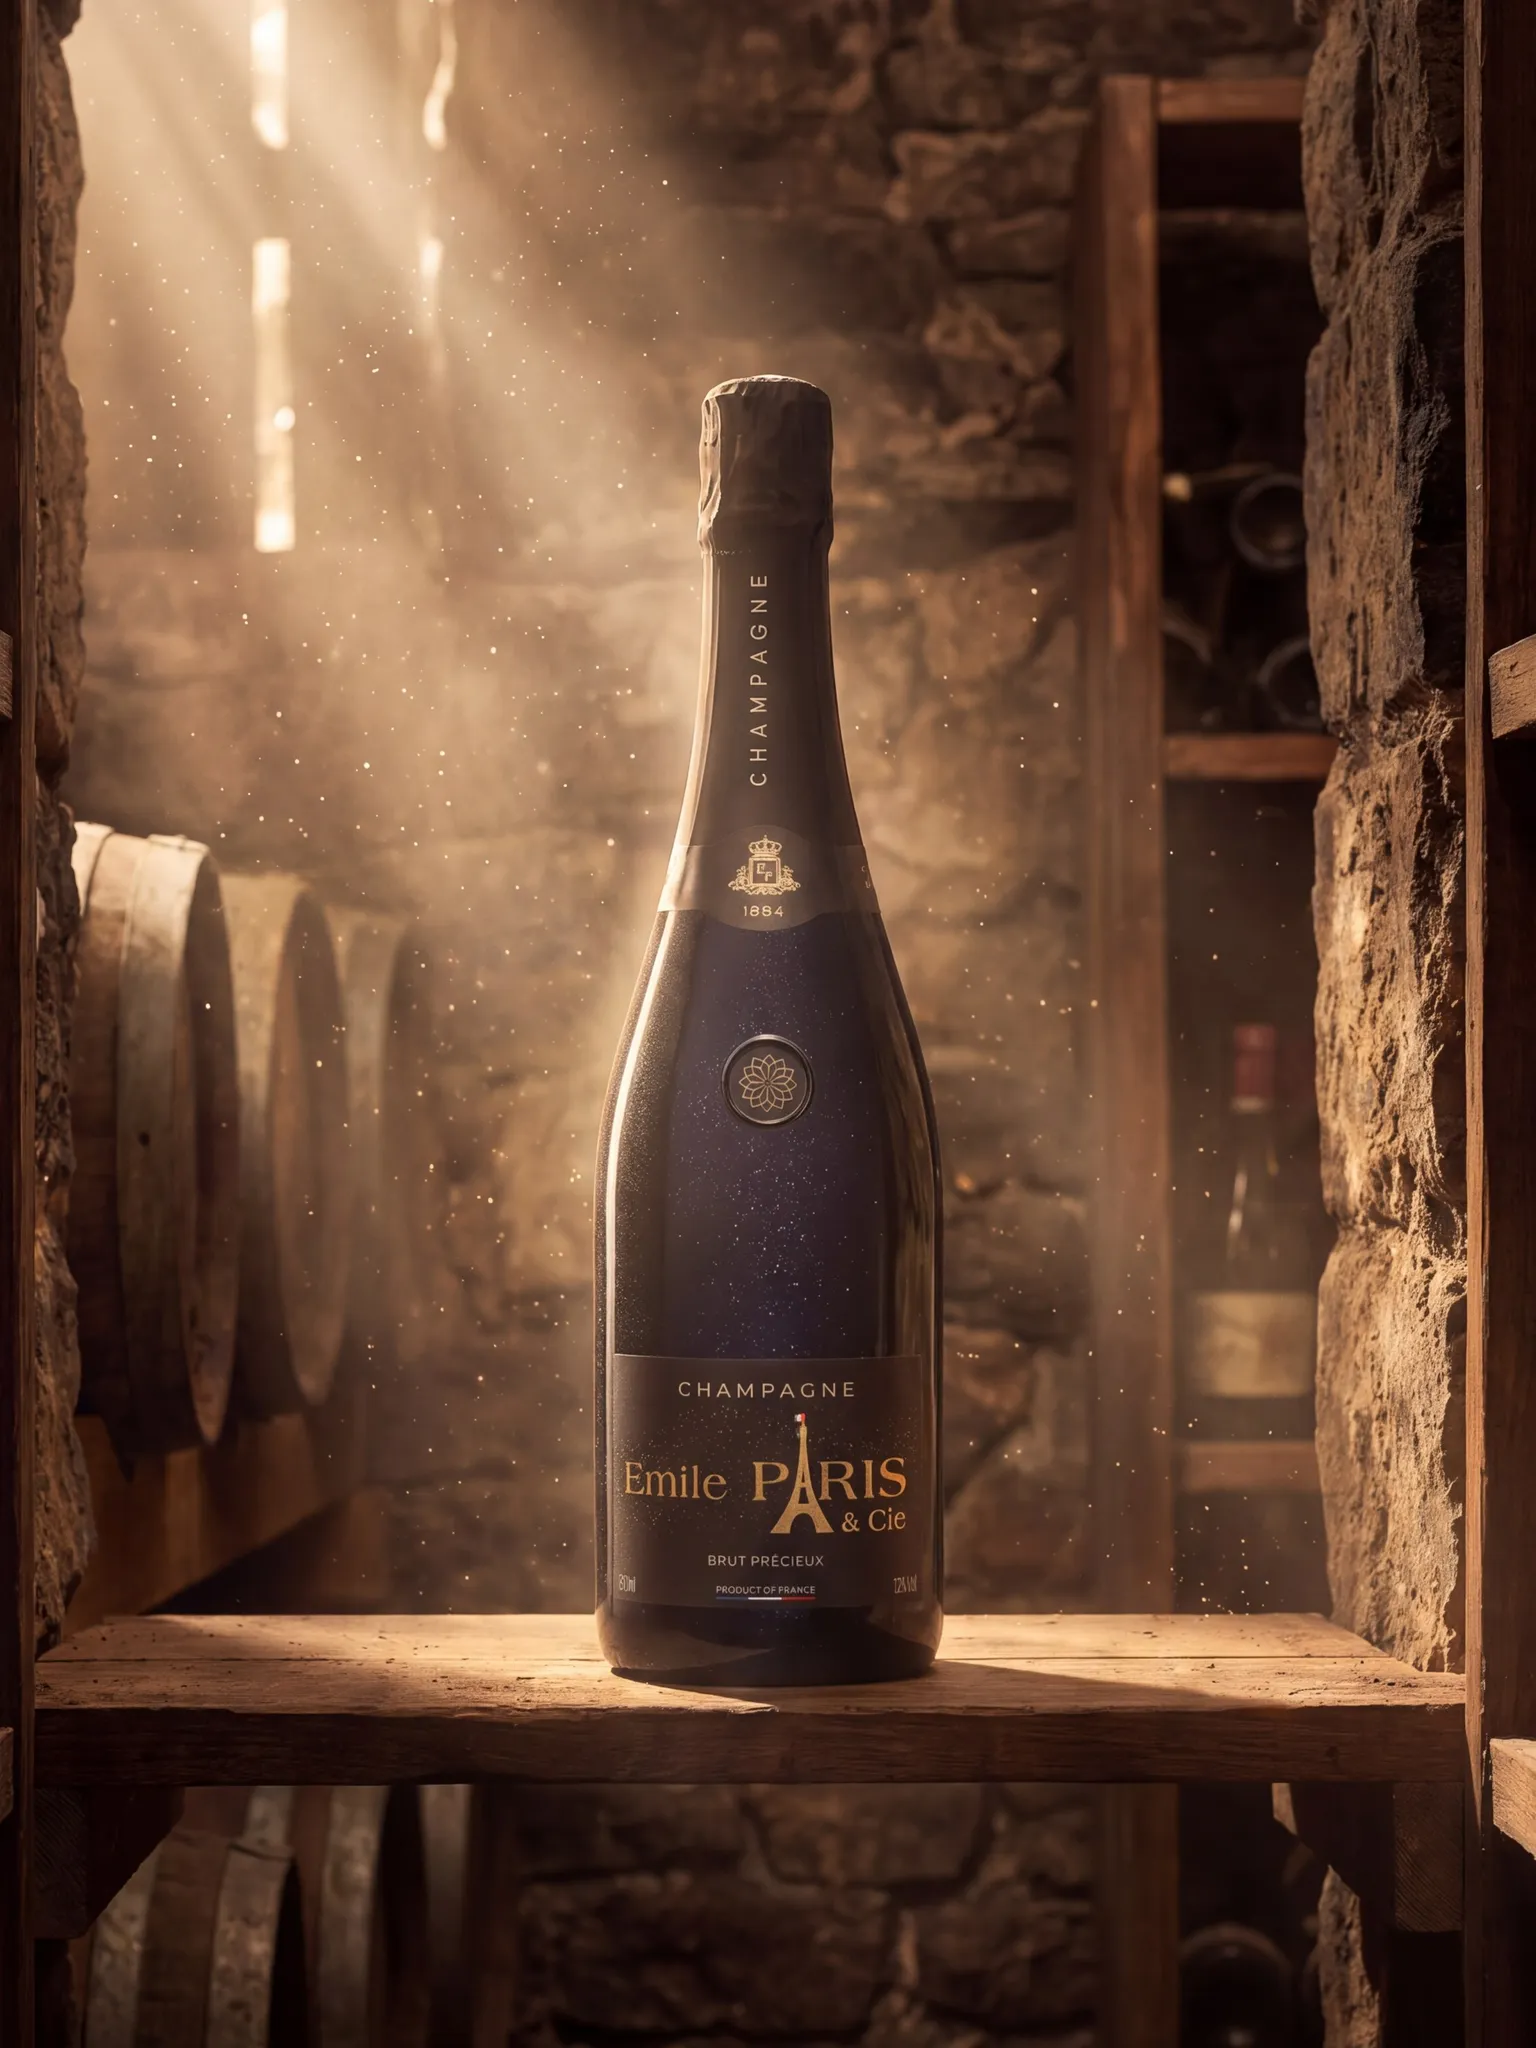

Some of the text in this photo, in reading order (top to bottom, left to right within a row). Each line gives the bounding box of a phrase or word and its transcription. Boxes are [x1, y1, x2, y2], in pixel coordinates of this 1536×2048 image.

[749, 575, 768, 787] CHAMPAGNE
[743, 905, 784, 917] 1884
[678, 1381, 855, 1398] CHAMPAGNE
[624, 1461, 727, 1500] Emile
[841, 1507, 906, 1533] & Cie
[707, 1553, 824, 1567] BRUT PRÉCIEUX
[715, 1585, 816, 1595] PRODUCT OF FRANCE
